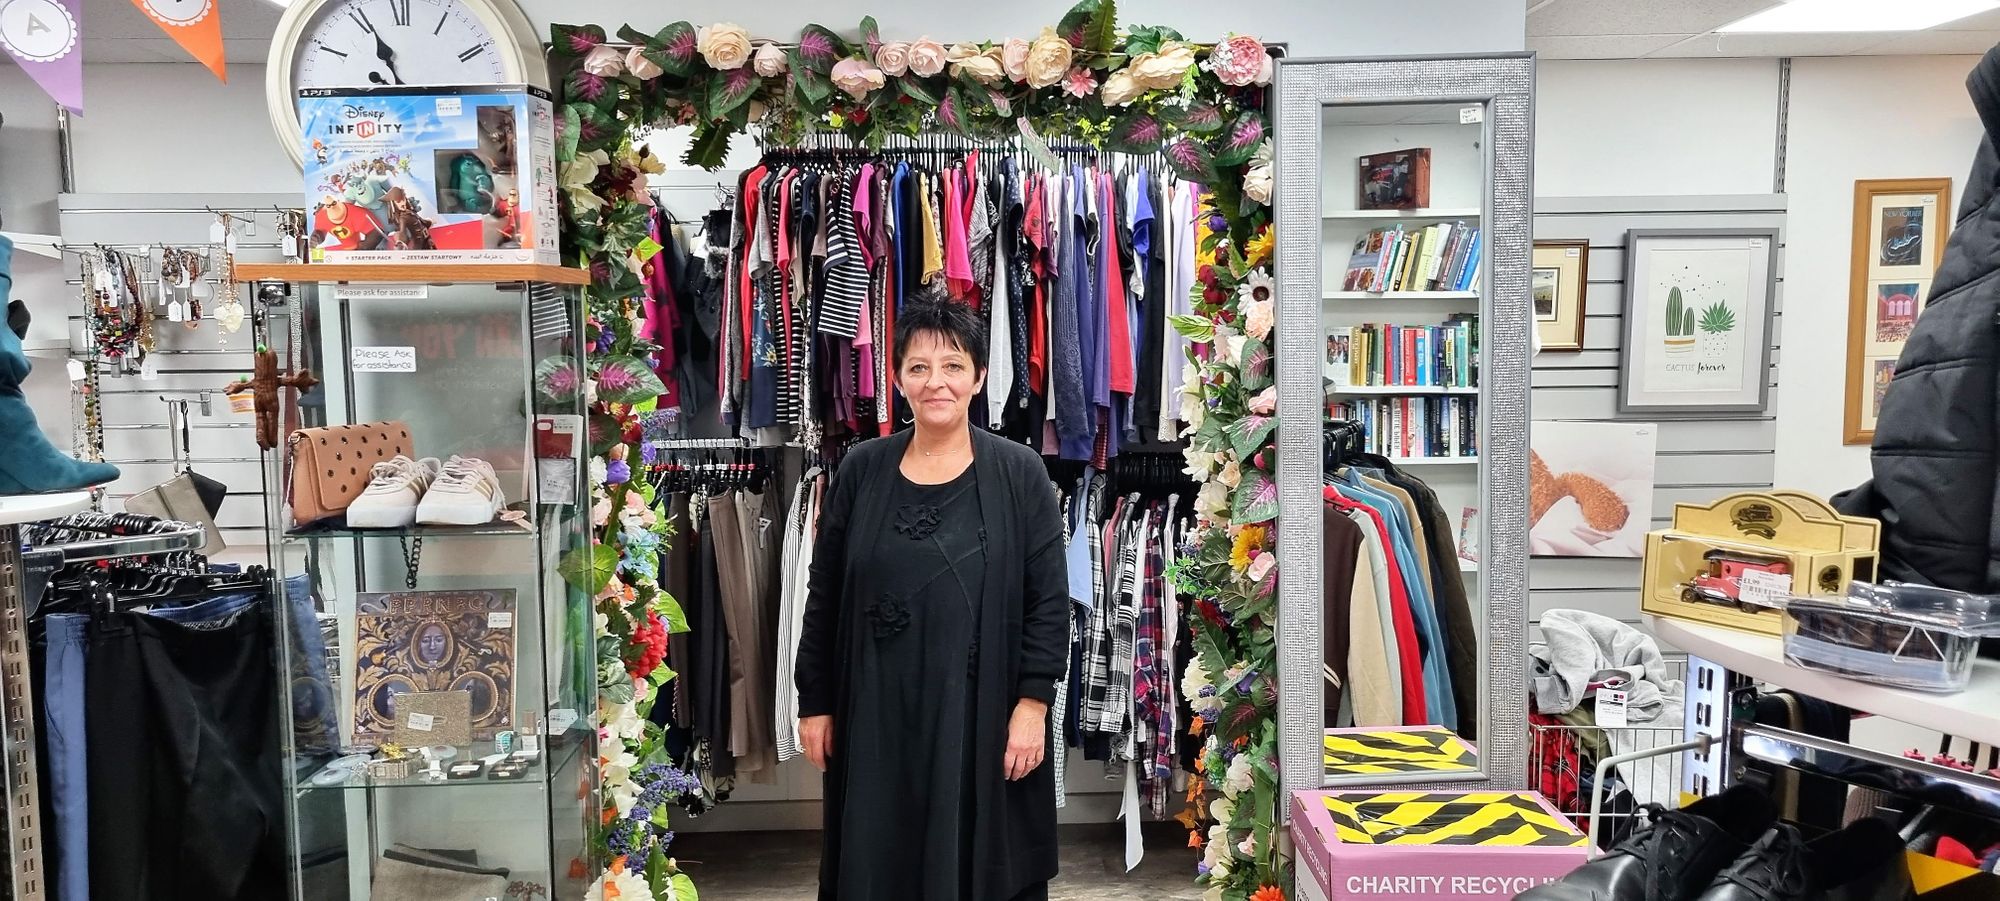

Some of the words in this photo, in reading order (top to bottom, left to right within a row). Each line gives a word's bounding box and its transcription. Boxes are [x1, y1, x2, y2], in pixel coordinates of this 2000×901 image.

[26, 12, 51, 36] A
[329, 121, 402, 138] INFINITY
[355, 348, 390, 359] Please
[353, 358, 365, 369] for
[366, 359, 412, 369] assistance
[1665, 364, 1695, 372] CACTUS
[1697, 361, 1726, 375] forever
[1346, 875, 1445, 894] CHARITY
[1451, 876, 1556, 894] RECYC
